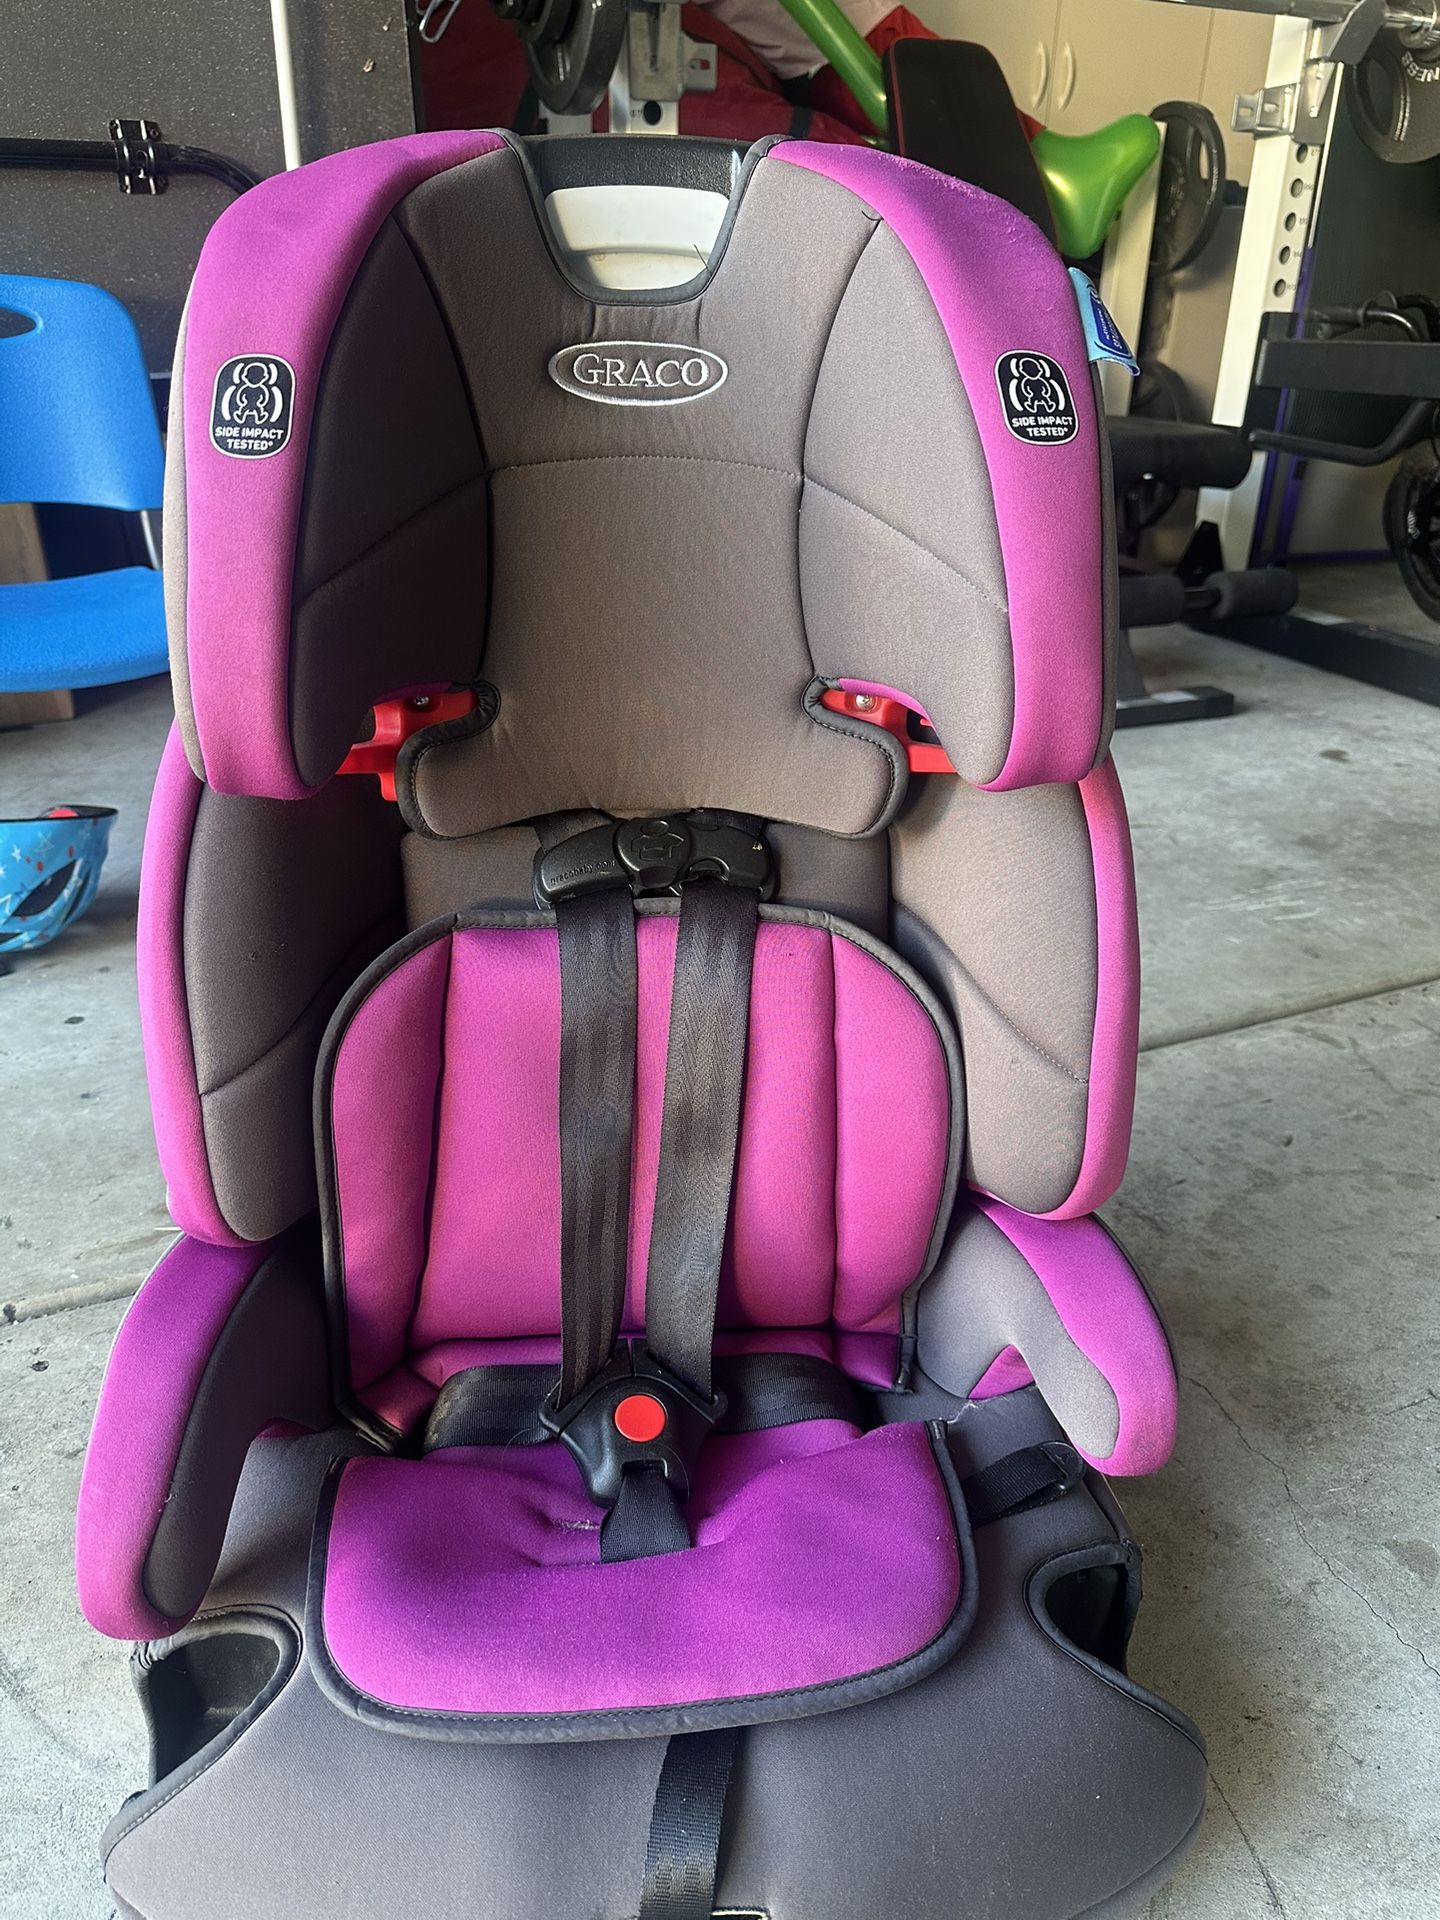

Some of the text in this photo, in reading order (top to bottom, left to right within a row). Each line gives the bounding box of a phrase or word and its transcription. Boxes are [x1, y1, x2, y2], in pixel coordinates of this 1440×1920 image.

[573, 353, 709, 388] GRACO
[1011, 416, 1073, 428] SIDE IMPACT
[214, 426, 284, 440] SIDE IMPACT
